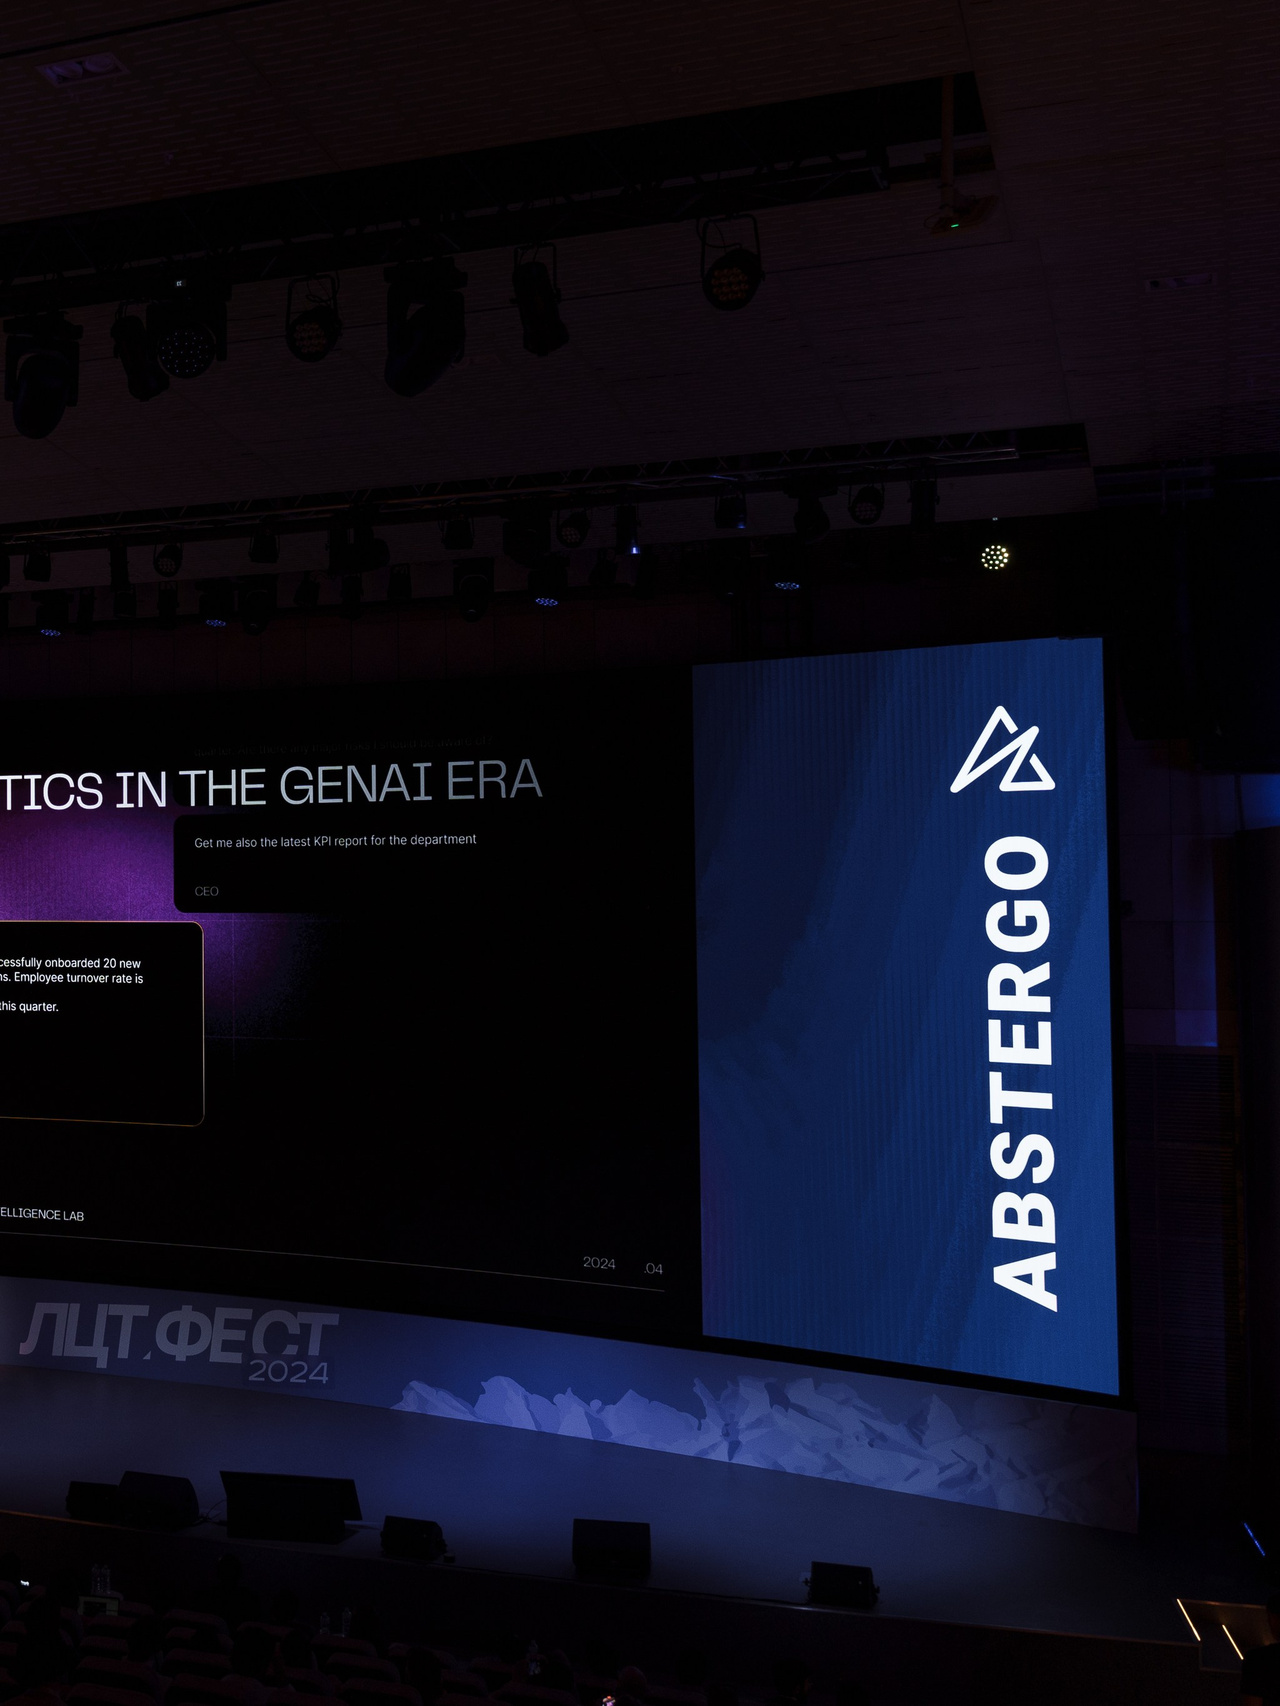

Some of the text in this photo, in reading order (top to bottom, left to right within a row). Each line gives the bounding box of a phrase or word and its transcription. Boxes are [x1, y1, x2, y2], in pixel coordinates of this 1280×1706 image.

[116, 771, 166, 808] IN
[179, 769, 266, 806] THE
[281, 763, 432, 804] GENAI
[448, 759, 542, 799] ERA
[195, 838, 213, 848] Get
[236, 838, 257, 847] also
[261, 837, 277, 847] the
[281, 837, 310, 846] latest
[315, 836, 331, 846] KPI
[335, 837, 367, 848] report
[371, 835, 385, 845] for
[390, 835, 407, 845] the
[411, 834, 476, 847] department
[195, 887, 218, 896] CEO
[45, 958, 100, 968] onboarded
[104, 958, 116, 968] 20
[15, 972, 63, 984] Employee
[67, 974, 109, 983] turnover
[112, 974, 132, 983] rate
[135, 974, 143, 983] is
[19, 1003, 58, 1013] quarter.
[983, 834, 1059, 1313] ABSTERGO
[64, 1211, 84, 1221] LAB
[584, 1257, 615, 1269] 2024
[248, 1359, 329, 1384] 2024
